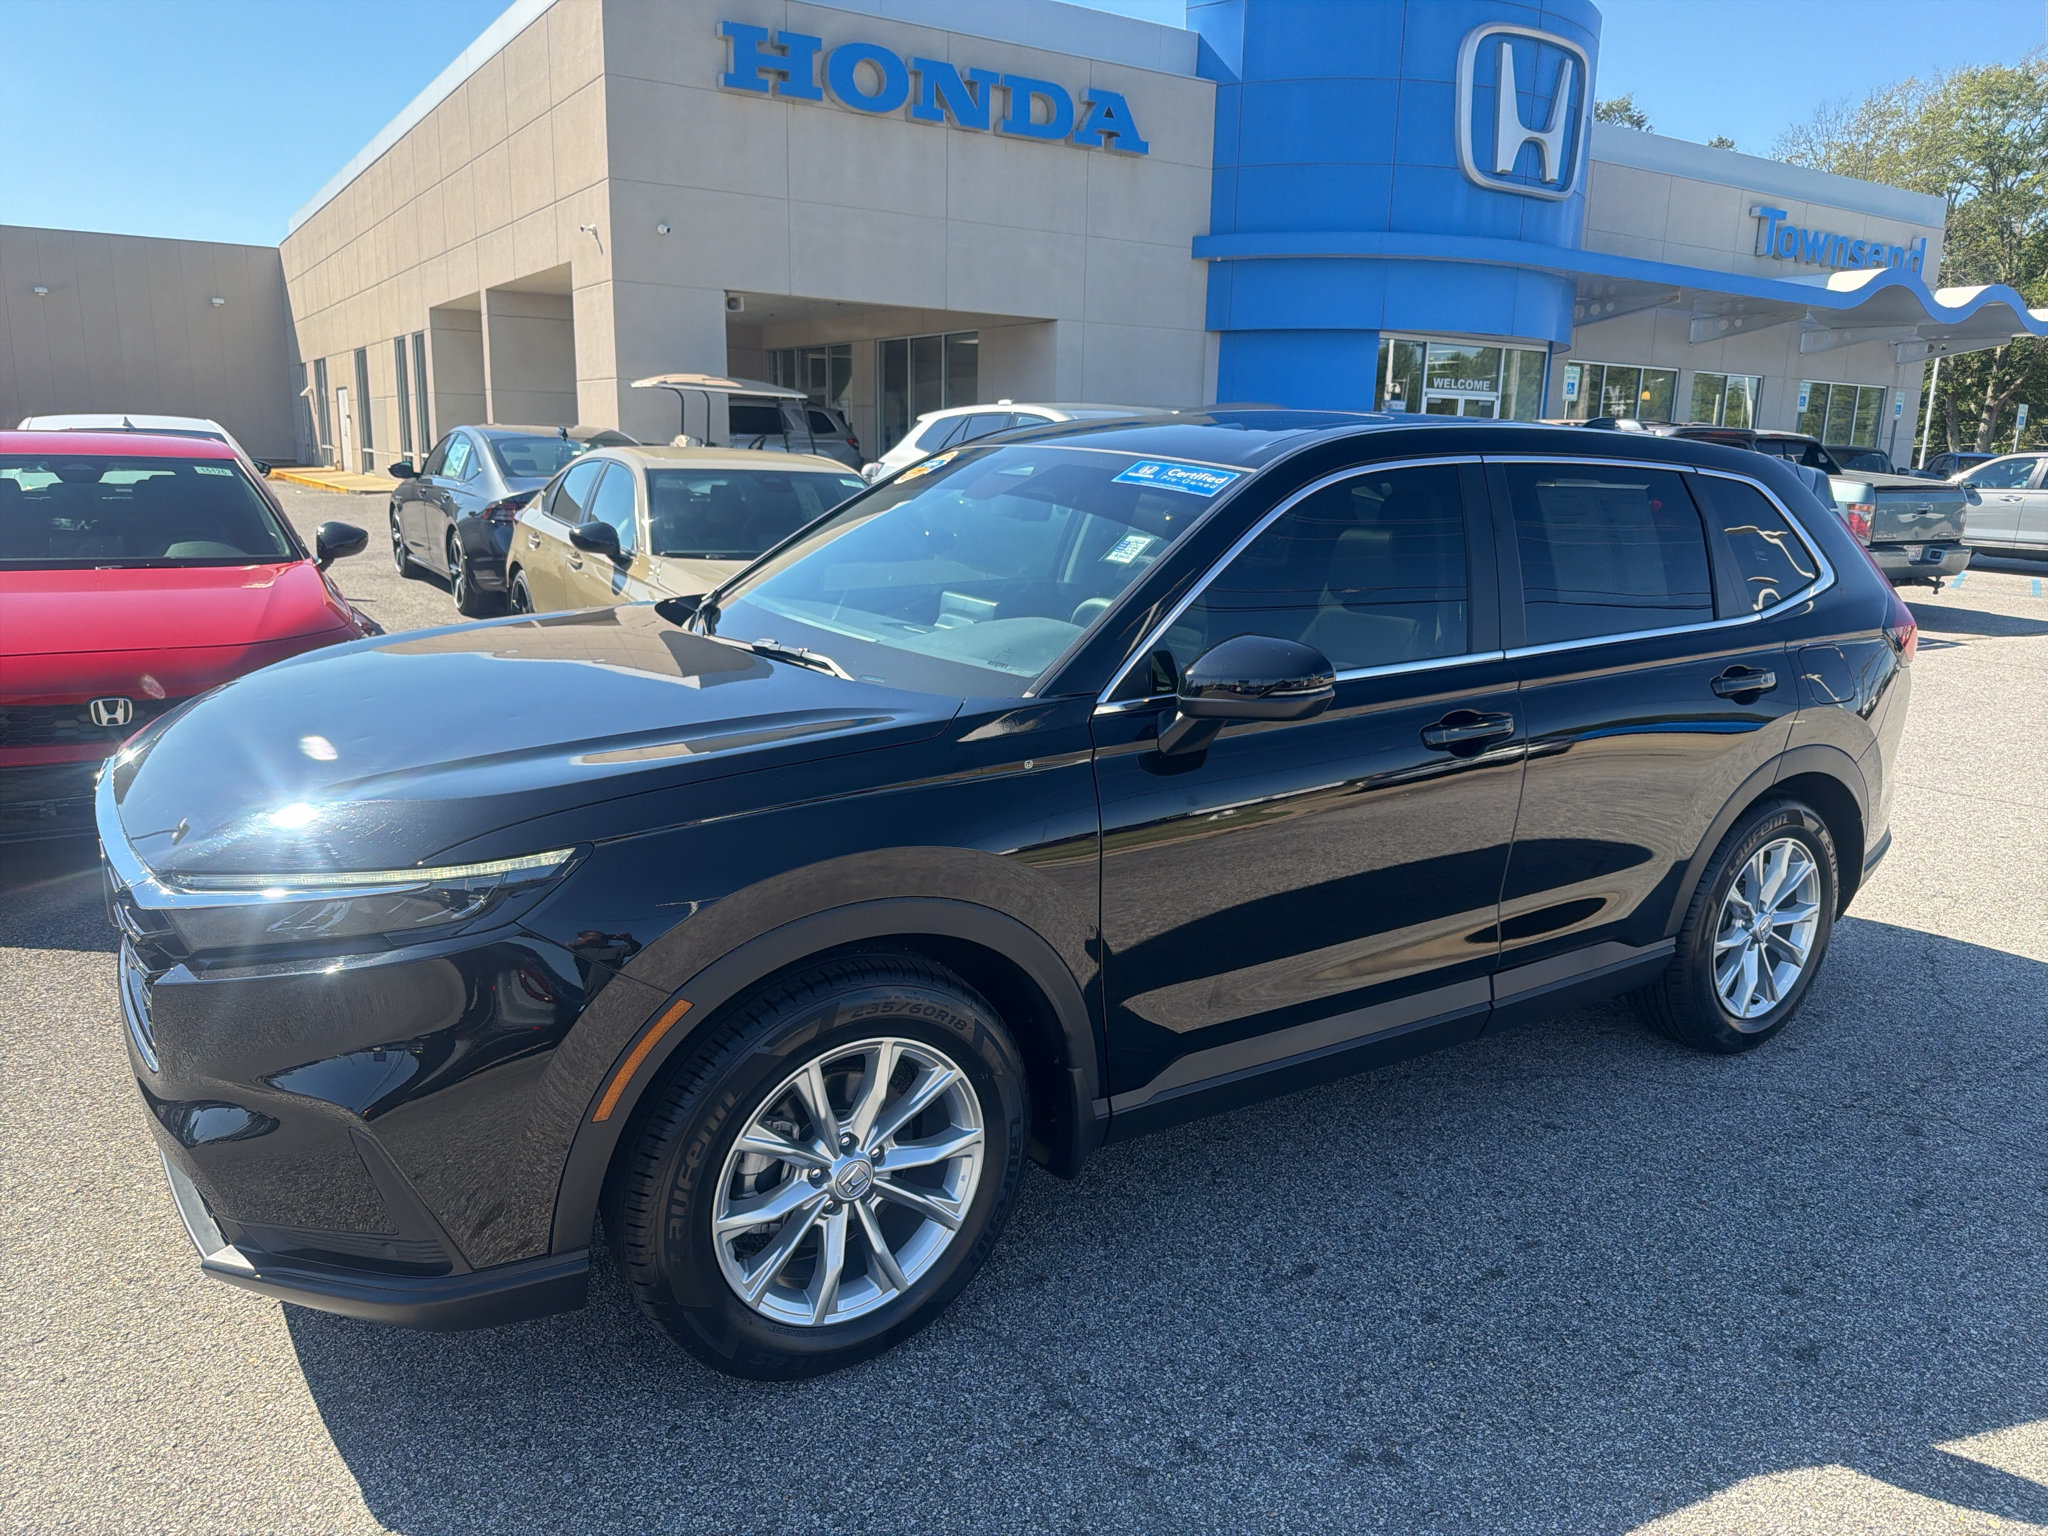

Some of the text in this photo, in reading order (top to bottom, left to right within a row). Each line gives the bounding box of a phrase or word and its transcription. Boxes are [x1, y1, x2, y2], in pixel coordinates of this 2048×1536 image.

[718, 21, 1149, 155] HONDA
[1751, 206, 1927, 275] Townsend
[1433, 377, 1491, 391] WELCOME
[1167, 468, 1228, 484] Certified
[851, 1002, 968, 1031] 235/60R18
